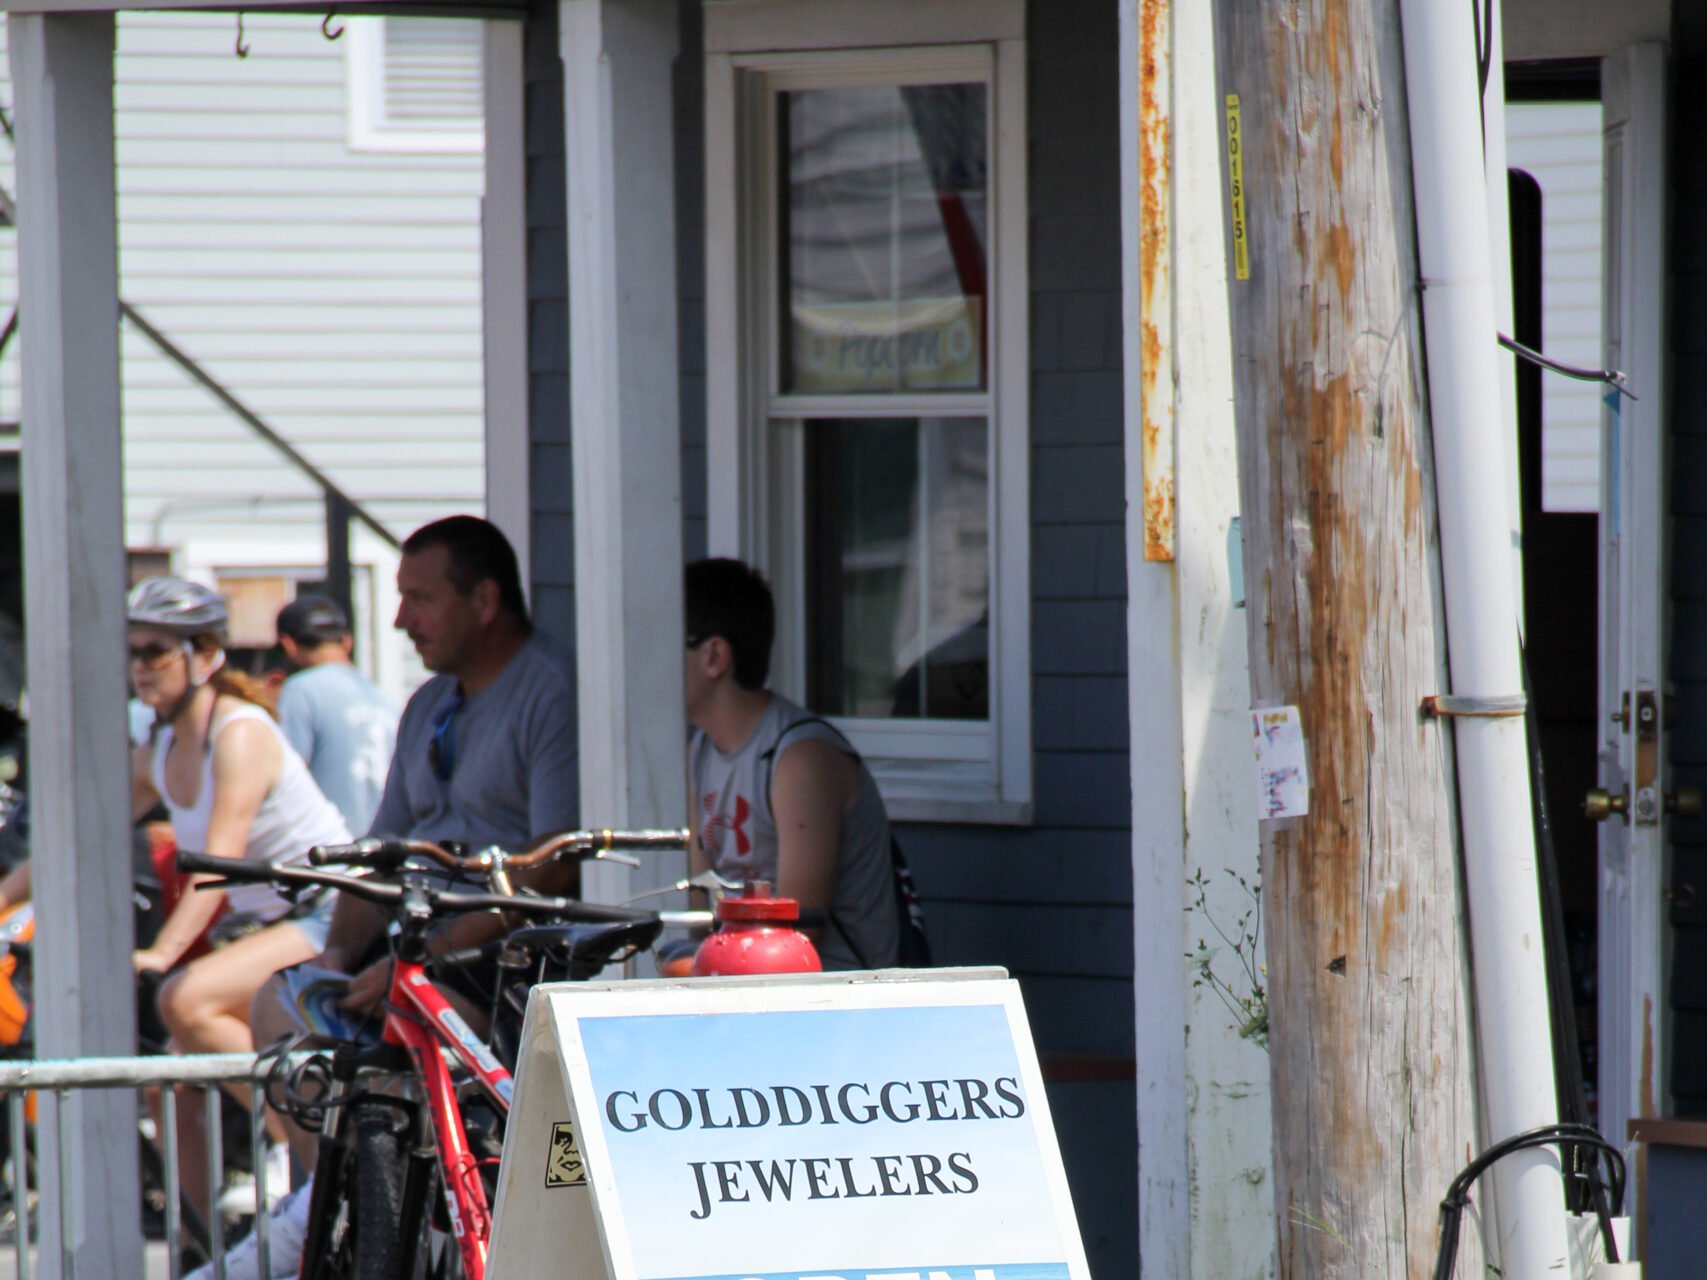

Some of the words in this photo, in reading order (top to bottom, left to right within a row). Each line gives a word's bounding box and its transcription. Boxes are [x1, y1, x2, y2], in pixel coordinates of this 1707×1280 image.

[1229, 115, 1243, 239] 001615
[605, 1077, 1025, 1133] GOLDDIGGERS
[686, 1152, 979, 1220] JEWELERS
